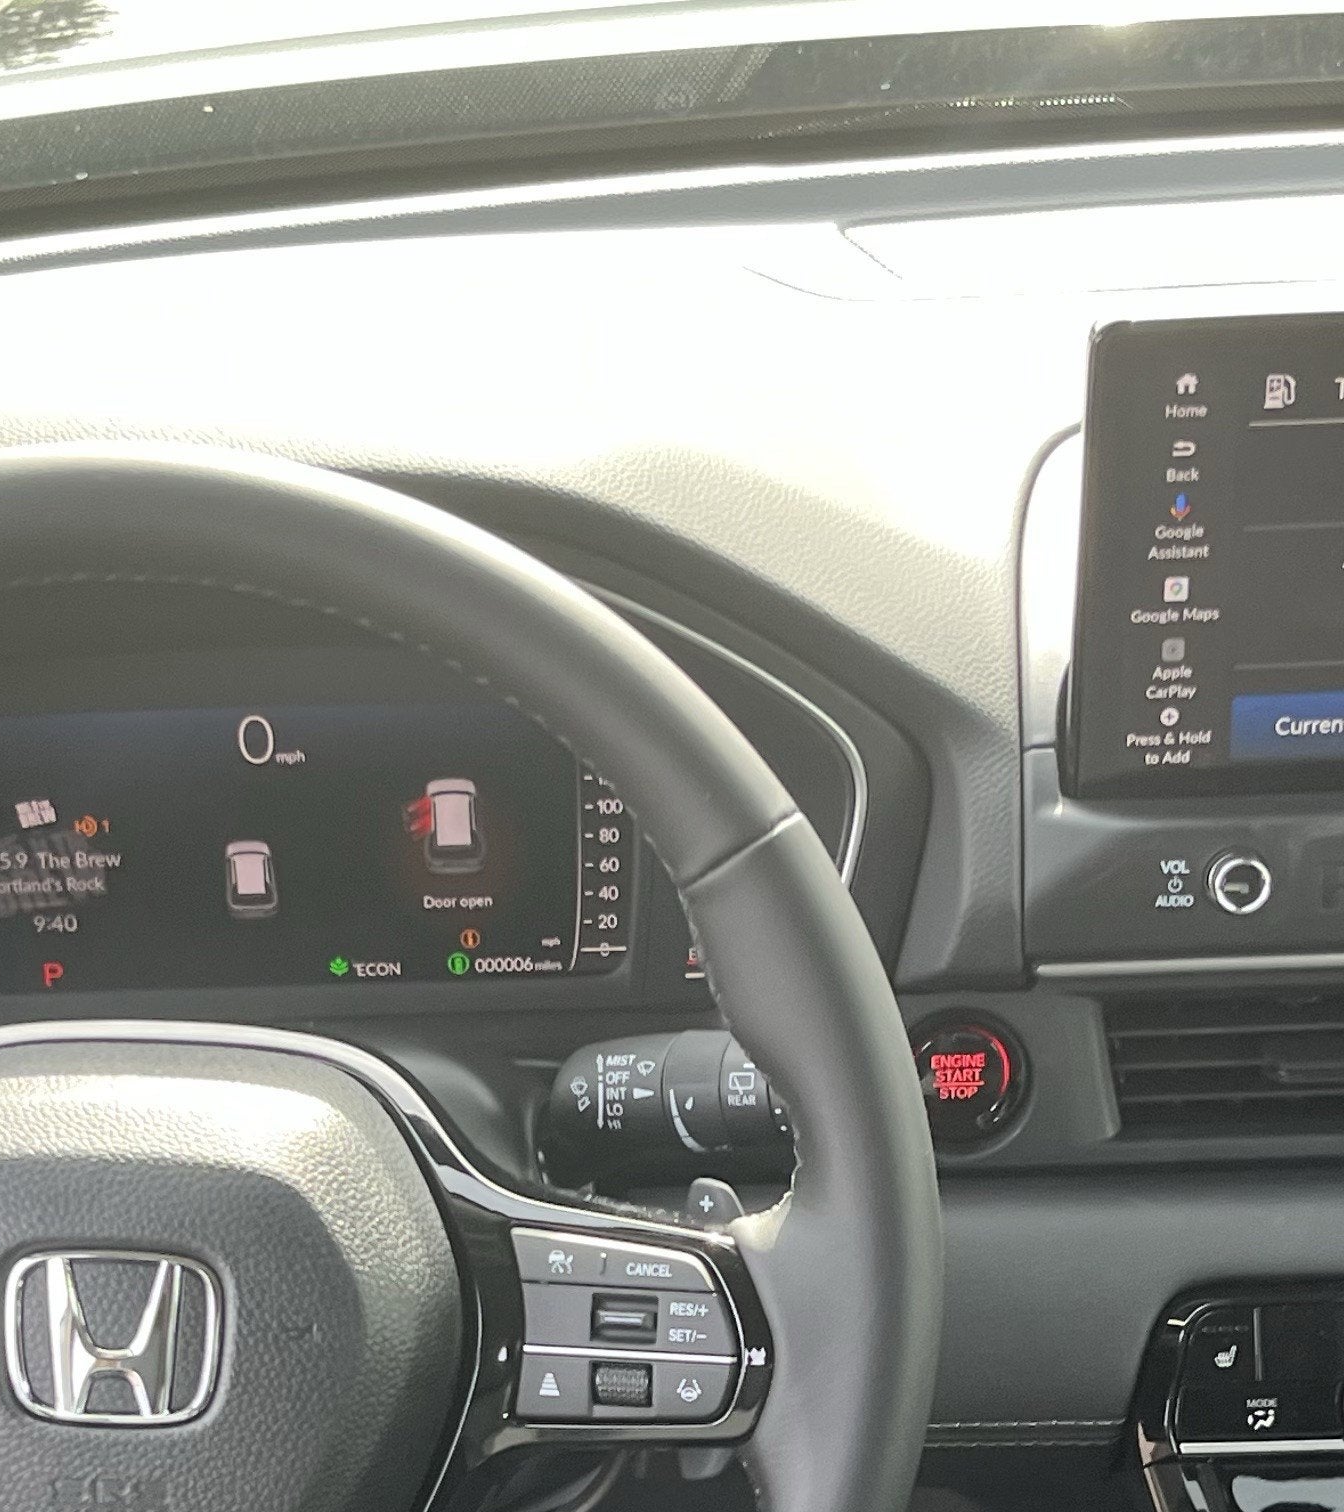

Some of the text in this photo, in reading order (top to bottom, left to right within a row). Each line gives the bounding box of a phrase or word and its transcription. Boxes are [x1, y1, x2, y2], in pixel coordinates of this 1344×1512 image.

[1165, 404, 1208, 419] Home
[1166, 468, 1199, 483] Back
[1155, 524, 1204, 541] Google
[1147, 545, 1209, 560] Assistant
[1130, 607, 1220, 625] Google Maps
[1151, 665, 1193, 681] Apple
[1145, 684, 1197, 701] CarPlay
[238, 714, 306, 765] 0 mph
[1126, 730, 1211, 748] Press & Hold
[1145, 750, 1191, 765] to Add
[596, 798, 624, 815] 100
[598, 827, 621, 844] 80
[37, 850, 70, 869] The
[75, 850, 122, 869] Brew
[599, 856, 620, 873] 60
[1160, 860, 1190, 874] VOL
[66, 876, 105, 892] Rock
[598, 885, 619, 901] 40
[1155, 894, 1194, 908] AUDIO
[423, 895, 494, 912] Door open
[33, 913, 78, 933] 9:40
[598, 914, 618, 930] 20
[356, 961, 402, 977] ECON
[474, 956, 533, 973] 000006
[42, 961, 64, 987] P
[606, 1054, 636, 1067] MIST
[931, 1052, 985, 1070] ENGINE
[606, 1071, 630, 1084] OFF
[935, 1068, 983, 1081] START
[606, 1087, 627, 1100] INT
[728, 1094, 756, 1107] REAR
[940, 1086, 978, 1100] STOP
[606, 1103, 624, 1117] LO
[626, 1261, 672, 1278] CANCEL
[1246, 1398, 1277, 1408] MODE
